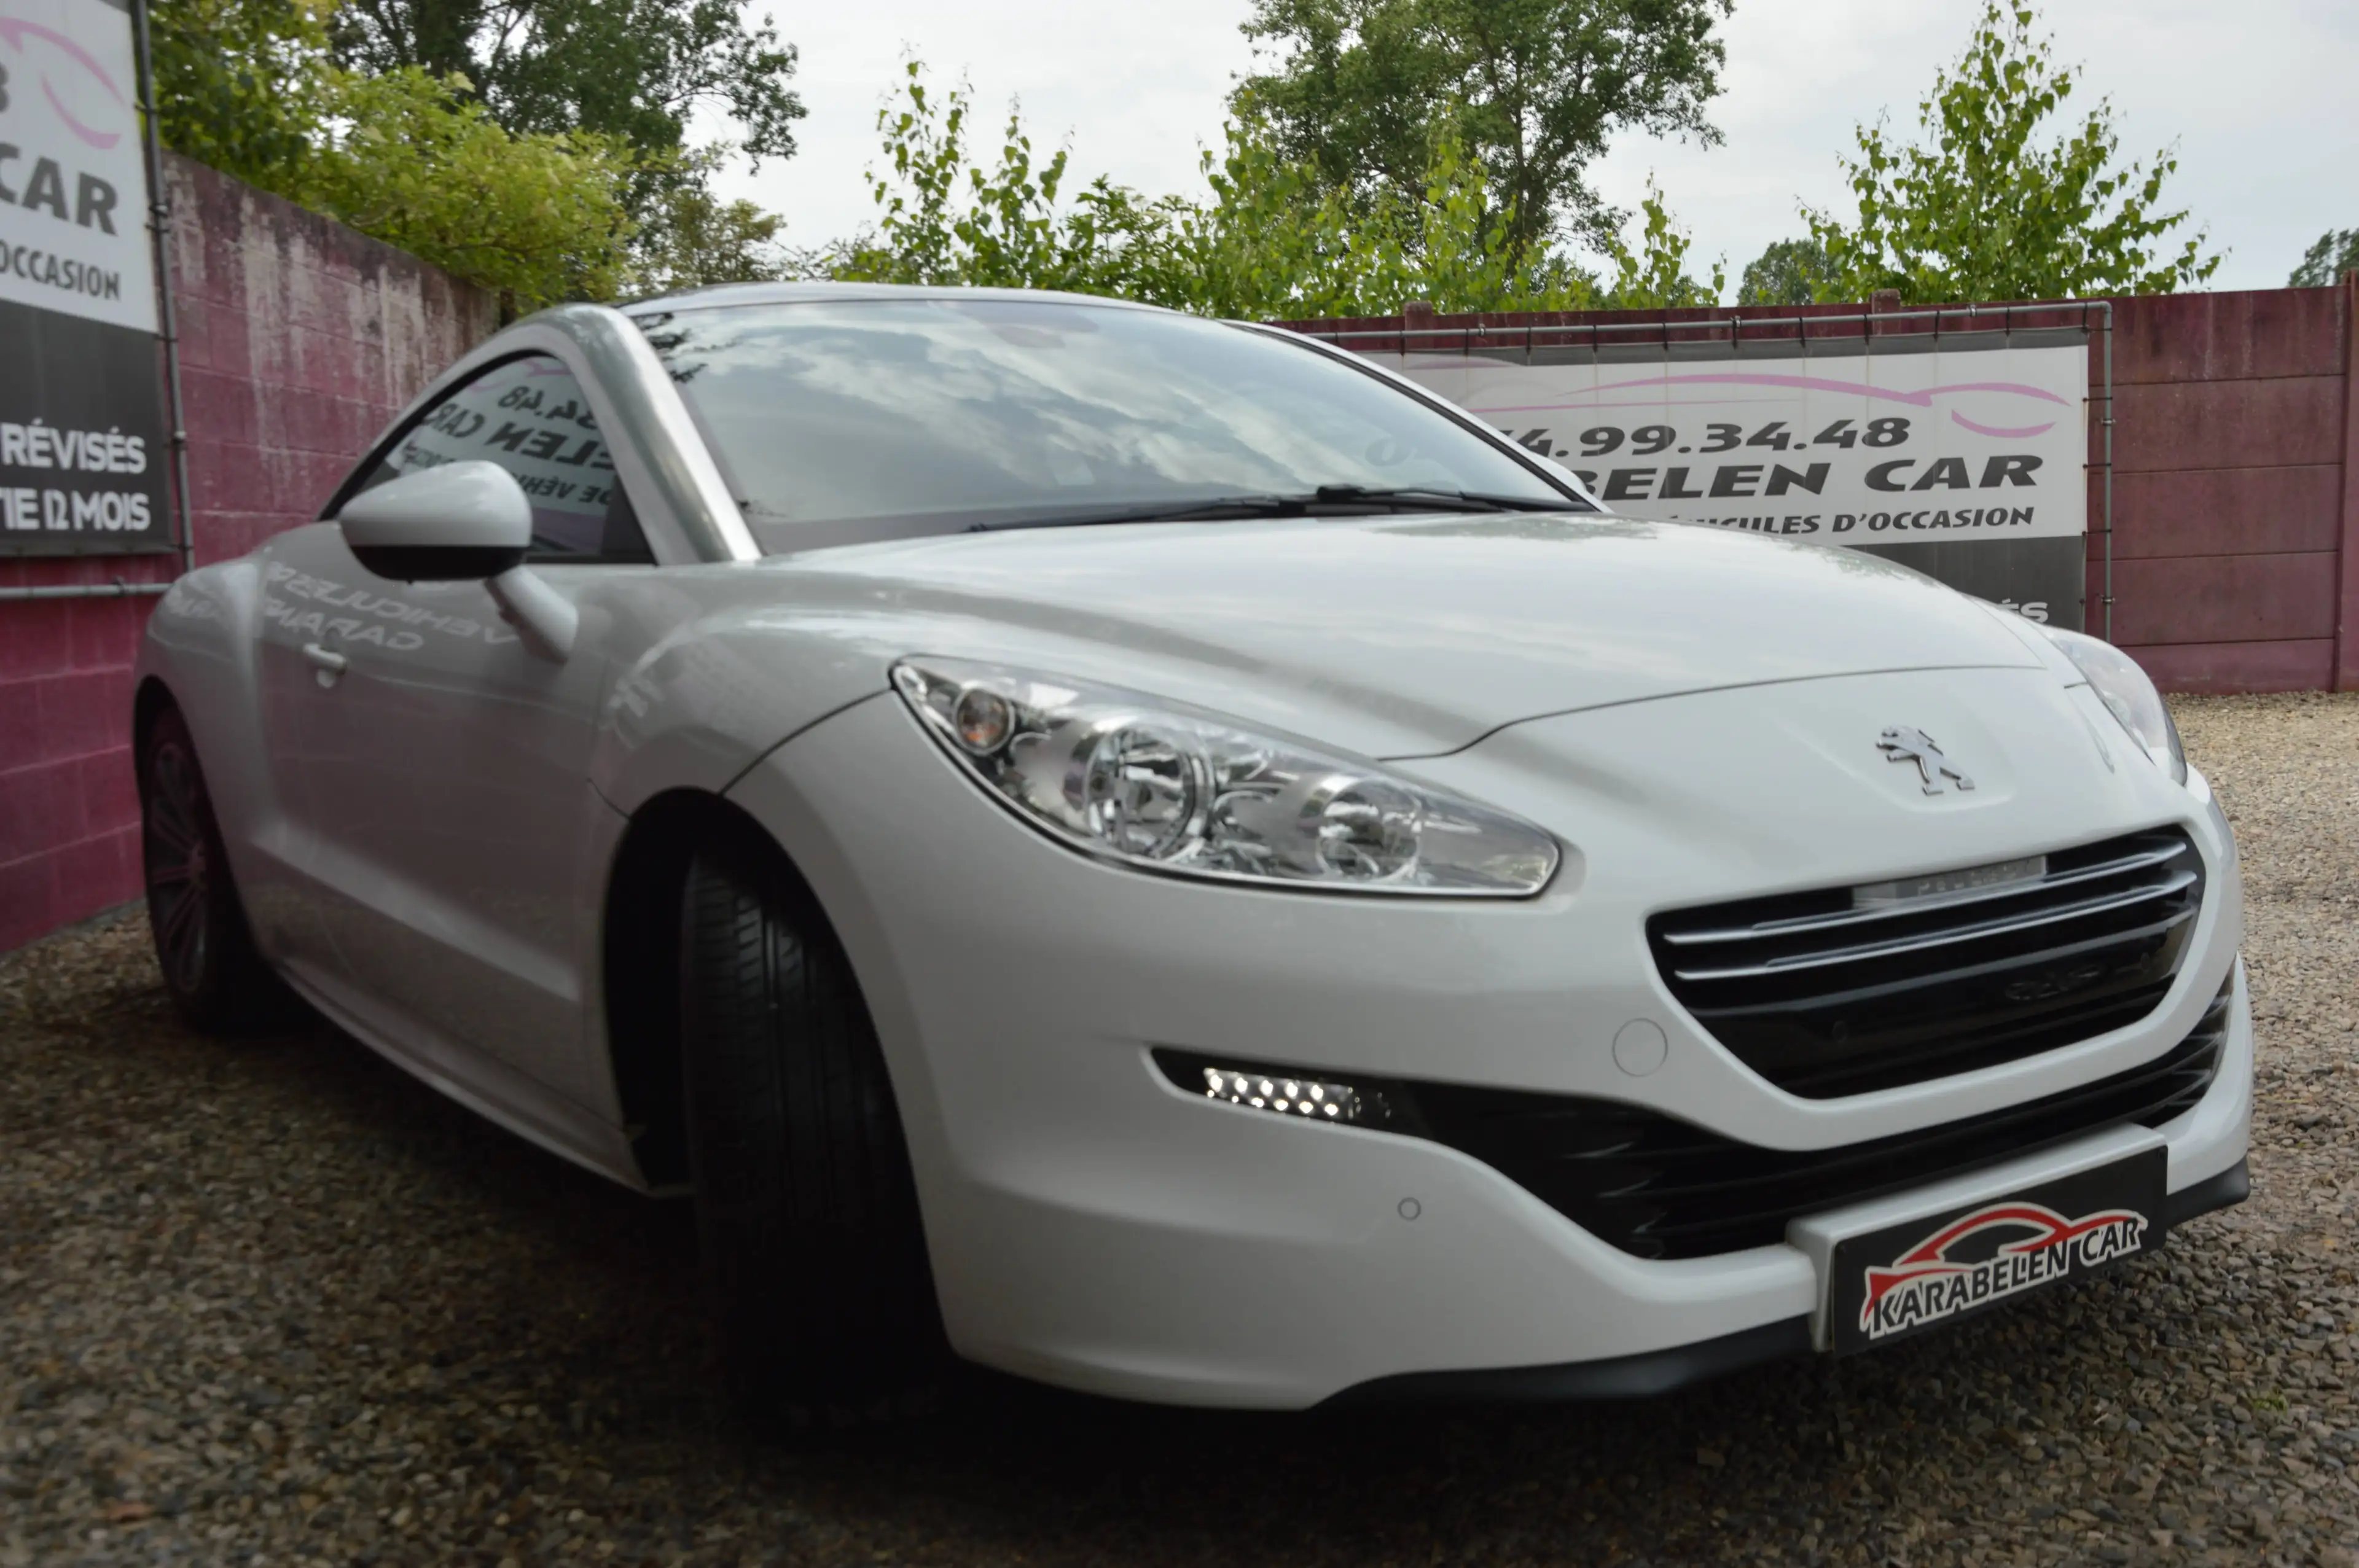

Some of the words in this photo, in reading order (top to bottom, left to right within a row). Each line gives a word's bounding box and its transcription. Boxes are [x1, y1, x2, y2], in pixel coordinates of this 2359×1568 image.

[0, 417, 147, 474] RÉVISÉS
[1864, 455, 2043, 492] CAR
[71, 491, 151, 531] MOIS
[1831, 507, 2035, 532] D'OCCASION
[1871, 1239, 2073, 1332] KARABELEN
[2080, 1216, 2140, 1263] CAR
